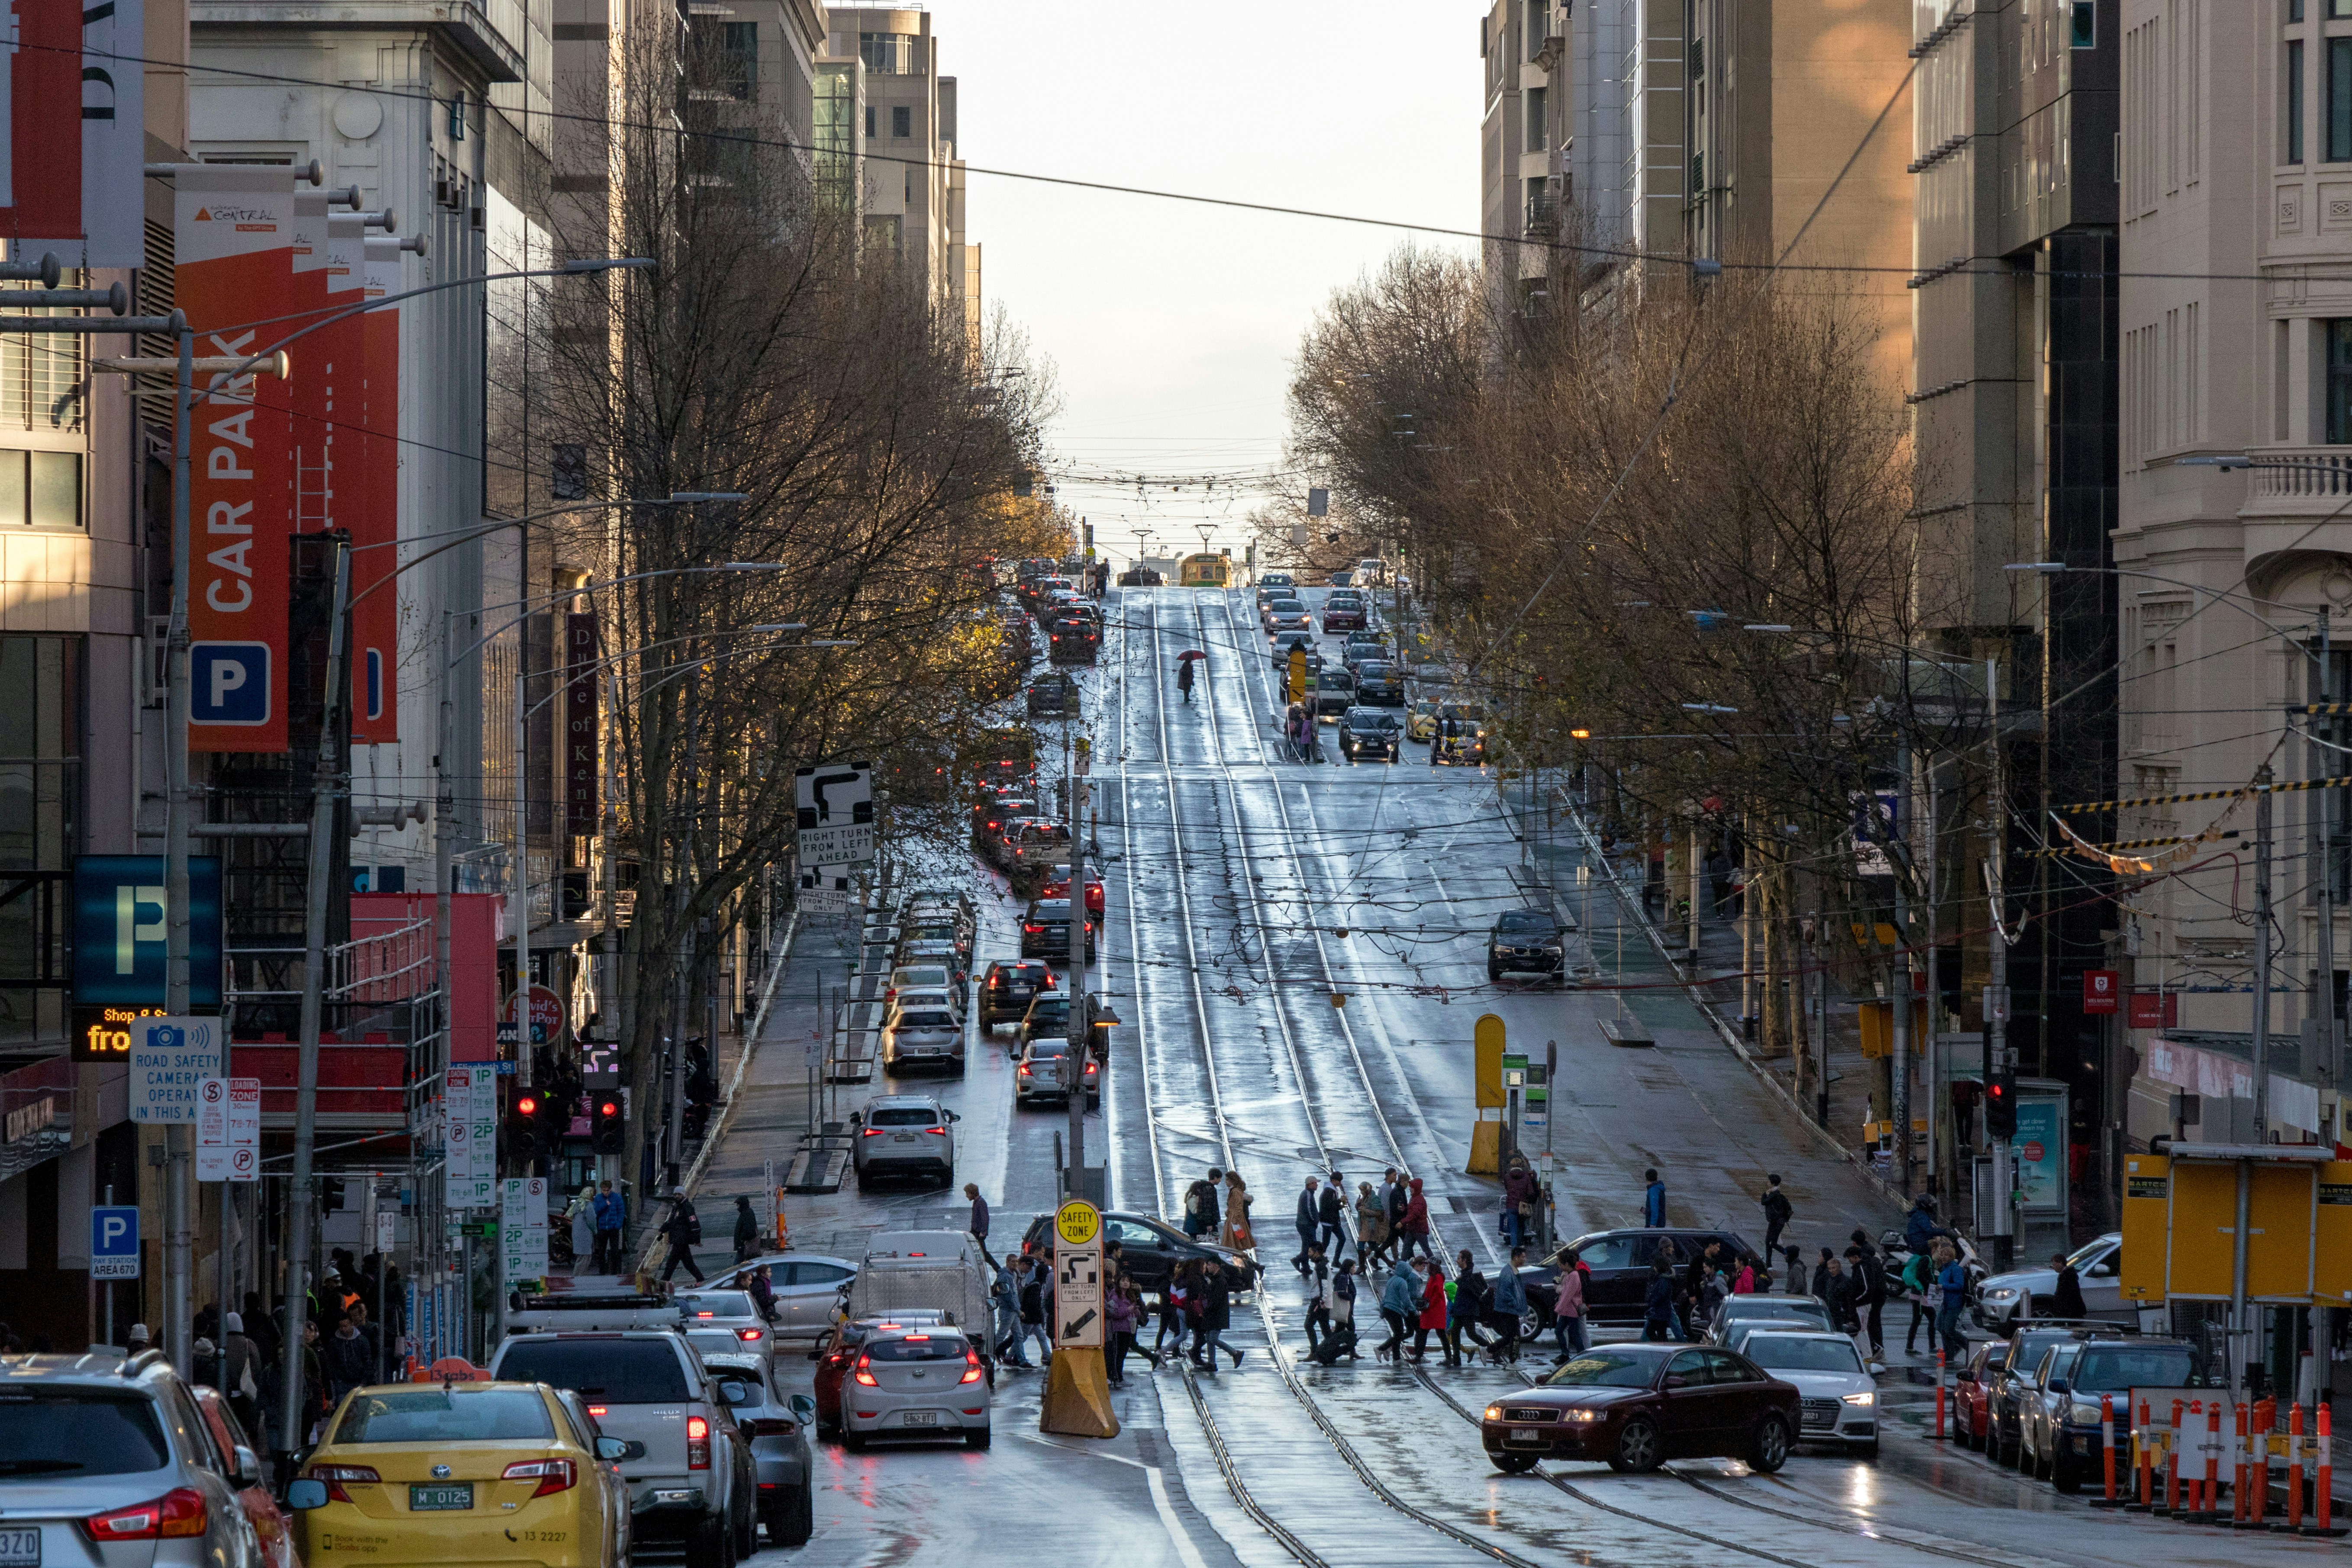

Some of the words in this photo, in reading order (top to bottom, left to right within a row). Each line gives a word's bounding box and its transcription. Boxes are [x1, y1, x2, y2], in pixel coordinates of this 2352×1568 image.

[207, 329, 255, 479] PARK
[206, 501, 253, 613] CAR
[576, 629, 590, 703] Duke
[211, 659, 247, 707] P
[572, 716, 591, 732] of
[574, 745, 590, 819] Kent
[801, 830, 835, 842] RIGHT
[840, 827, 871, 839] TURN
[803, 842, 834, 853] FROM
[842, 838, 869, 849] LEFT
[817, 850, 858, 862] AHEAD
[116, 886, 168, 974] P
[513, 999, 558, 1012] Dvid's
[104, 1009, 135, 1024] Shop
[87, 1025, 131, 1050] fro
[497, 1029, 518, 1040] AN
[136, 1055, 168, 1067] ROAD
[175, 1055, 219, 1067] SAFETY
[476, 1070, 491, 1082] 1P
[231, 1081, 257, 1090] LOADING
[148, 1089, 197, 1102] OPERAT
[230, 1092, 258, 1100] ZONE
[136, 1107, 148, 1119] IN
[155, 1107, 181, 1119] THIS
[474, 1126, 493, 1138] 2P
[475, 1183, 490, 1196] 1P
[507, 1181, 520, 1193] 1P
[1061, 1212, 1093, 1223] SAFETY
[103, 1217, 126, 1248] P
[505, 1230, 523, 1242] 2P
[1067, 1226, 1089, 1236] ZONE
[94, 1265, 118, 1274] AREA
[120, 1265, 135, 1274] 670
[508, 1258, 521, 1269] 1P
[418, 1493, 426, 1503] M
[438, 1491, 470, 1503] 0125
[525, 1531, 536, 1541] 13
[541, 1532, 567, 1542] 2227
